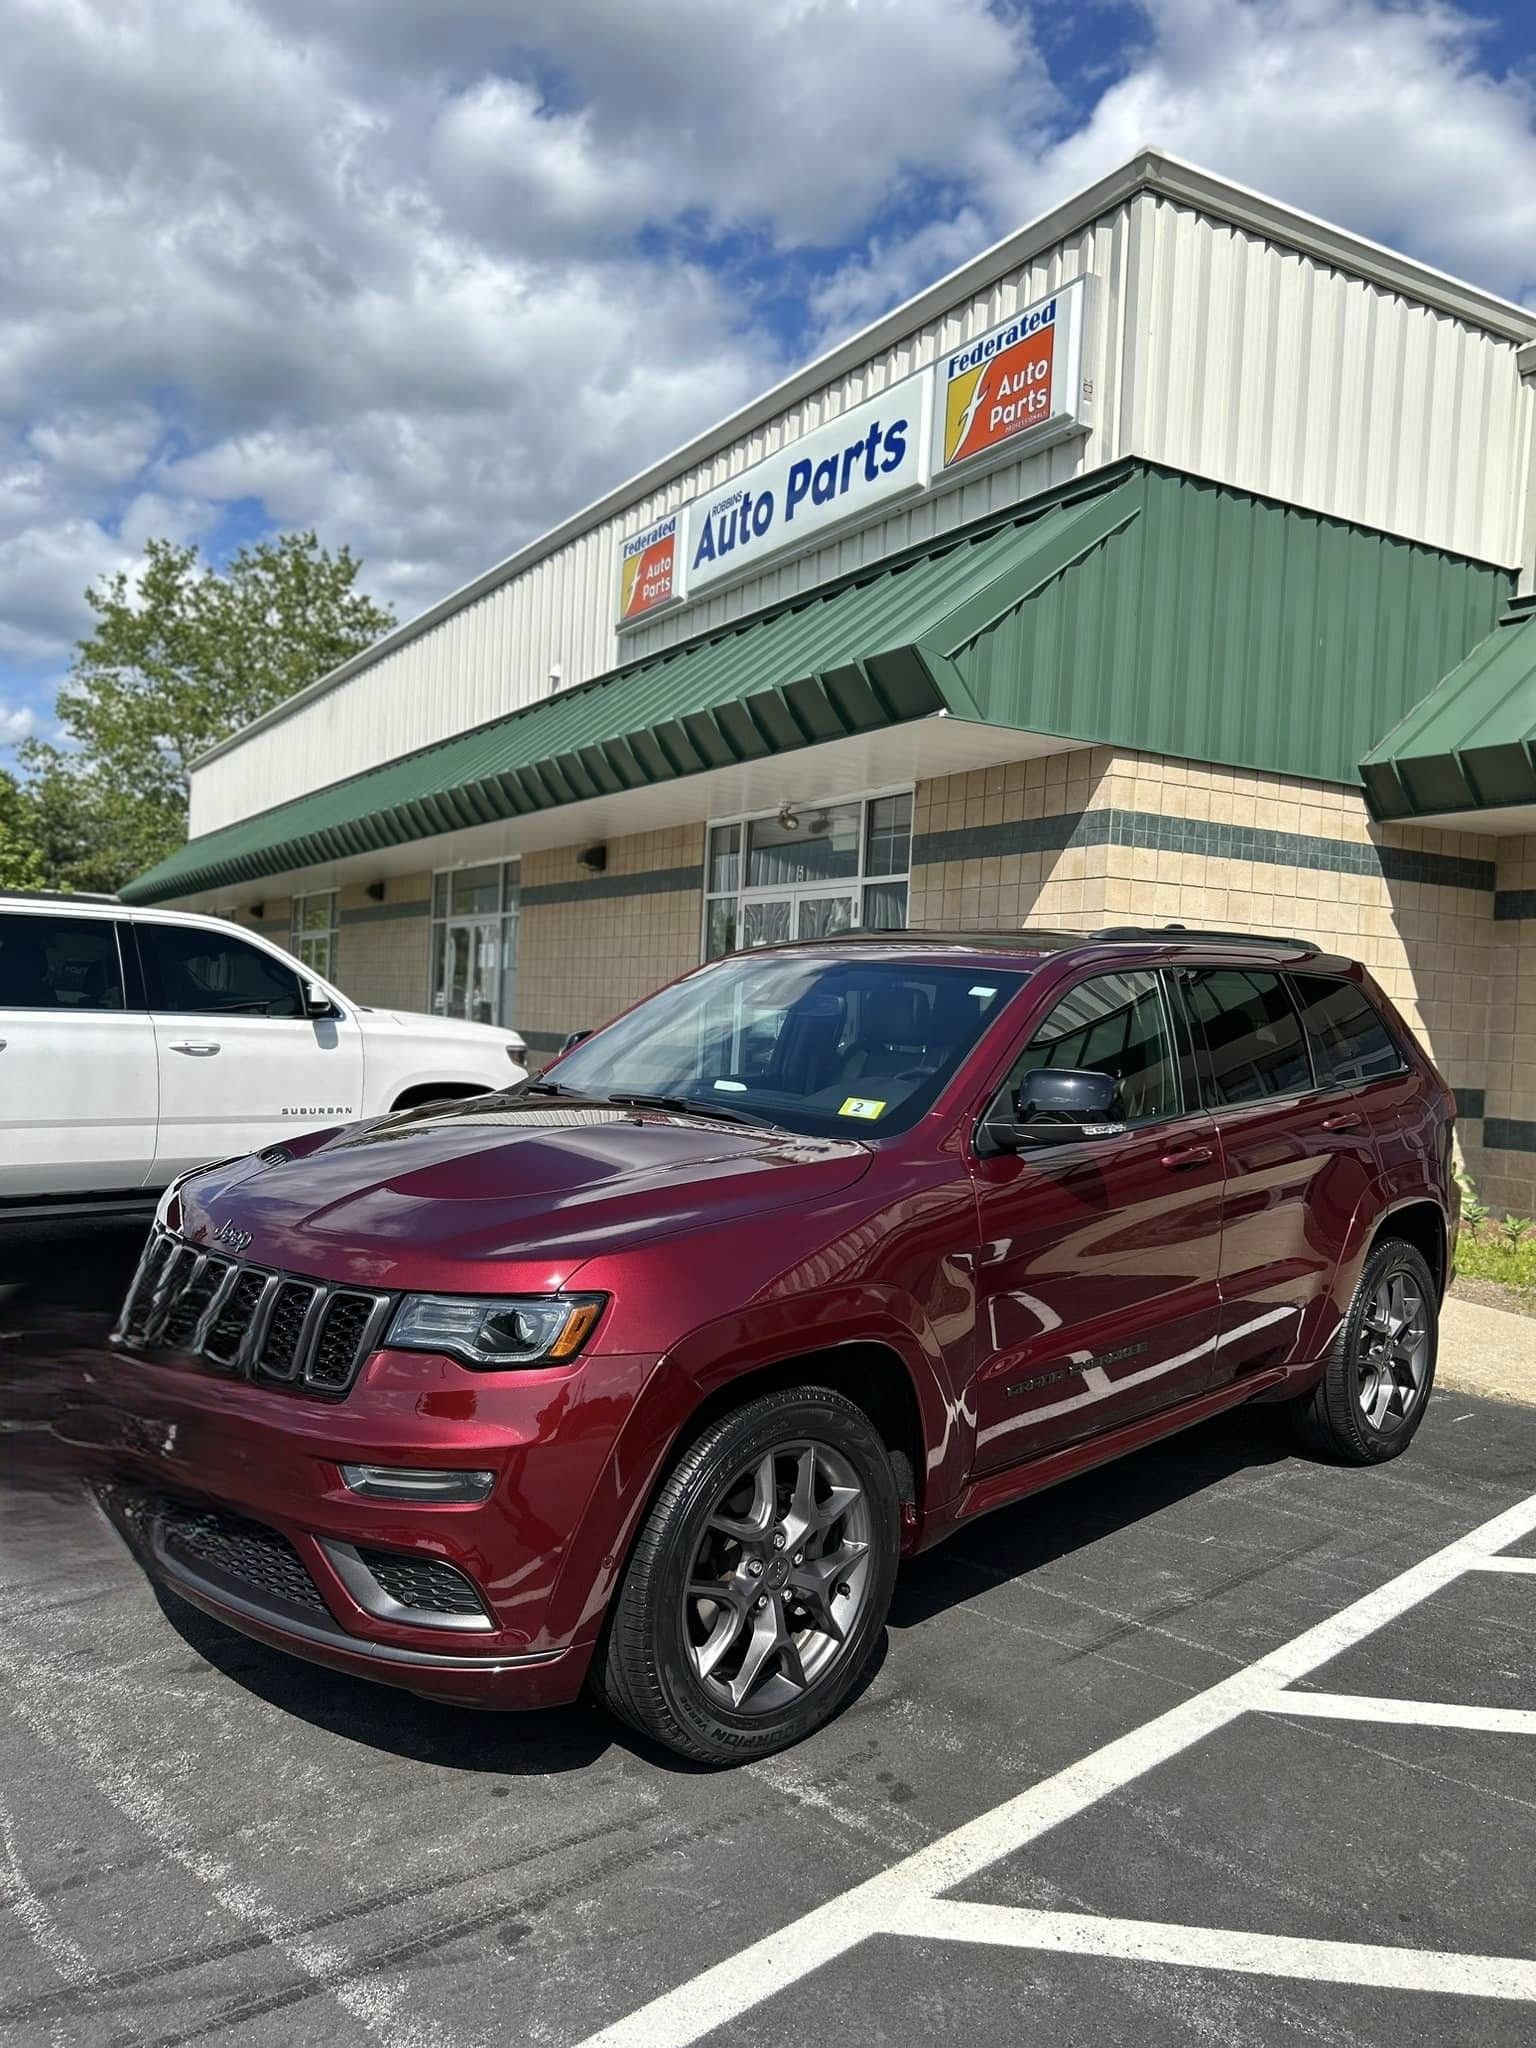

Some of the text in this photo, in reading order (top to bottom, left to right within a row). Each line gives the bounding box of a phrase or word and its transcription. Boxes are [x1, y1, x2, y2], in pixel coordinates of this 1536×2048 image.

[948, 298, 1056, 379] Federated
[997, 359, 1048, 400] Auto
[989, 388, 1047, 432] Parts
[692, 419, 908, 570] Auto Parts
[711, 490, 744, 518] ROBBINS
[623, 516, 676, 559] Federated
[646, 557, 671, 579] Auto
[642, 577, 671, 600] Parts
[281, 1106, 353, 1115] SUBURBAN
[852, 1102, 864, 1112] 2
[213, 1218, 254, 1254] Jeep
